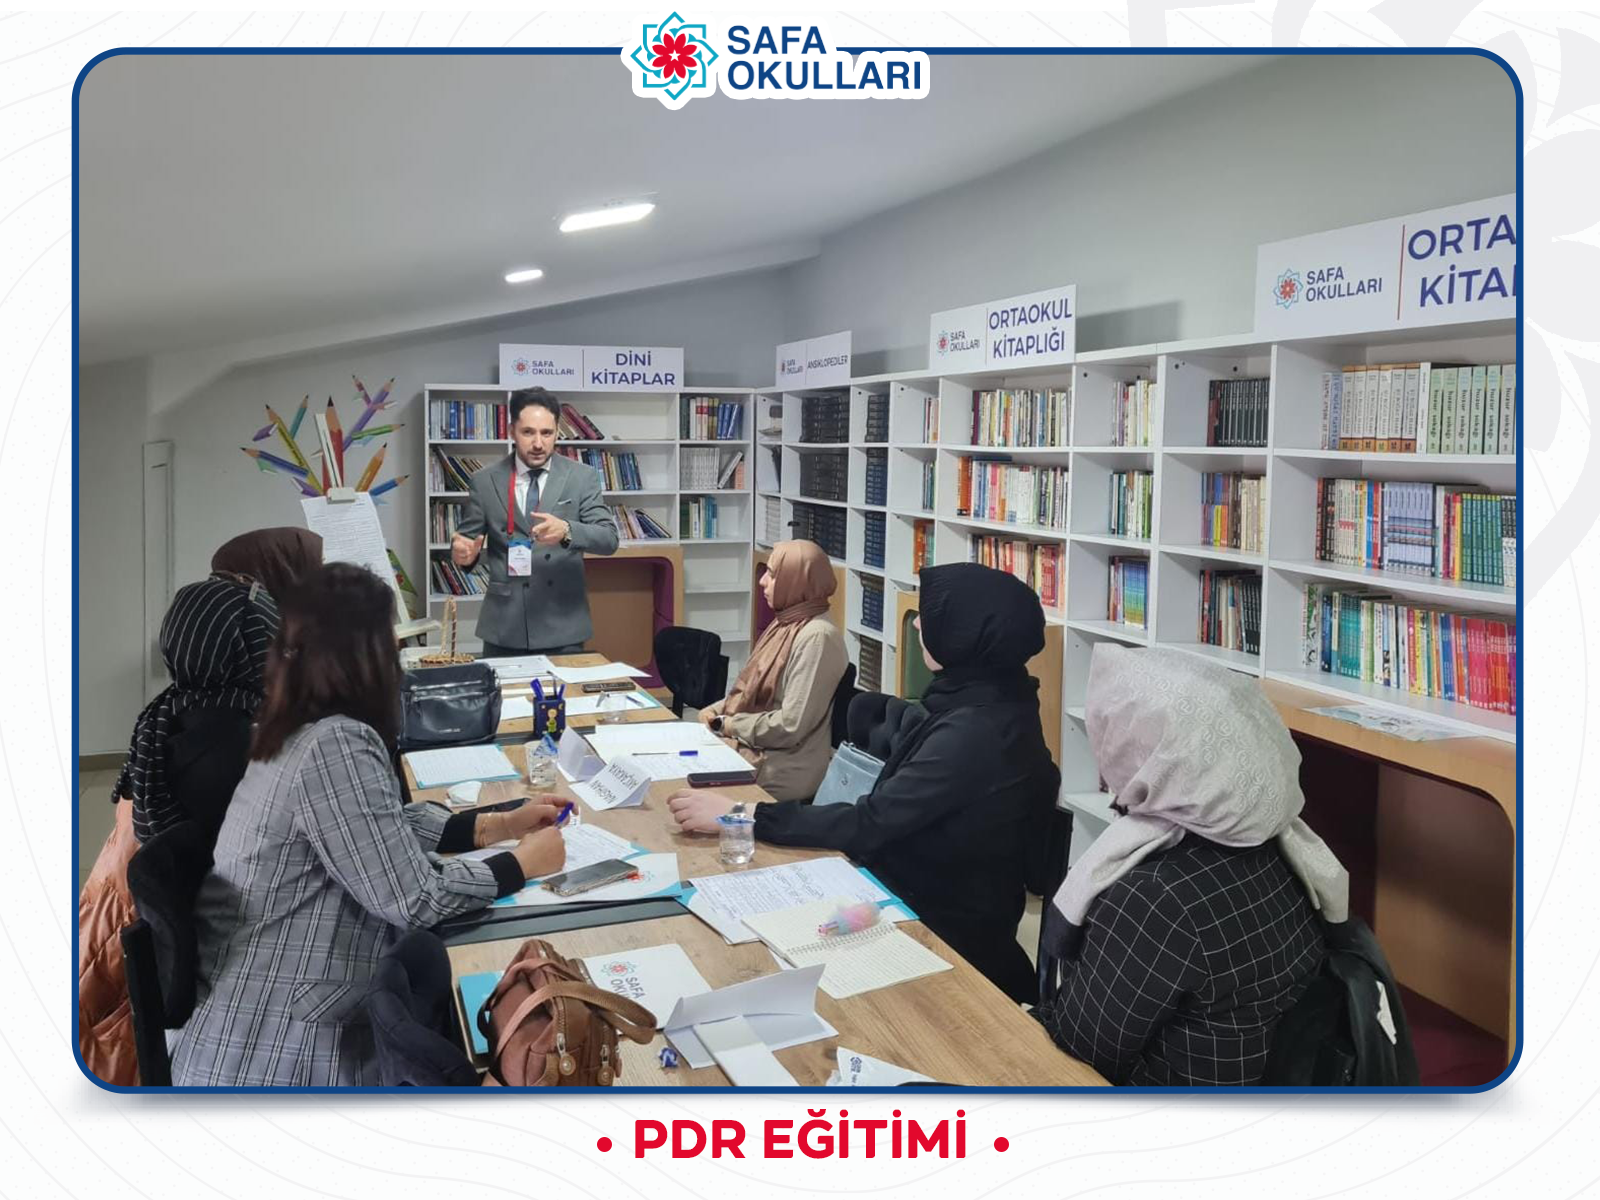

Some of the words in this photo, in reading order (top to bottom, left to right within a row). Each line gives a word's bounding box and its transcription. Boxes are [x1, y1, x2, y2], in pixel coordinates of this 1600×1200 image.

[1306, 266, 1344, 285] SAFA
[1305, 278, 1382, 302] OKULLARI
[1419, 264, 1516, 308] KİTA
[989, 298, 1072, 330] ORTAOKUL
[950, 331, 966, 342] SAFA
[950, 339, 980, 352] OKULLARI
[993, 327, 1065, 359] KİTAPLIĞI
[532, 360, 554, 368] SAFA
[616, 350, 651, 366] DİNİ
[532, 368, 575, 376] OKULLARI
[592, 368, 676, 386] KİTAPLAR
[625, 977, 645, 999] SAFA
